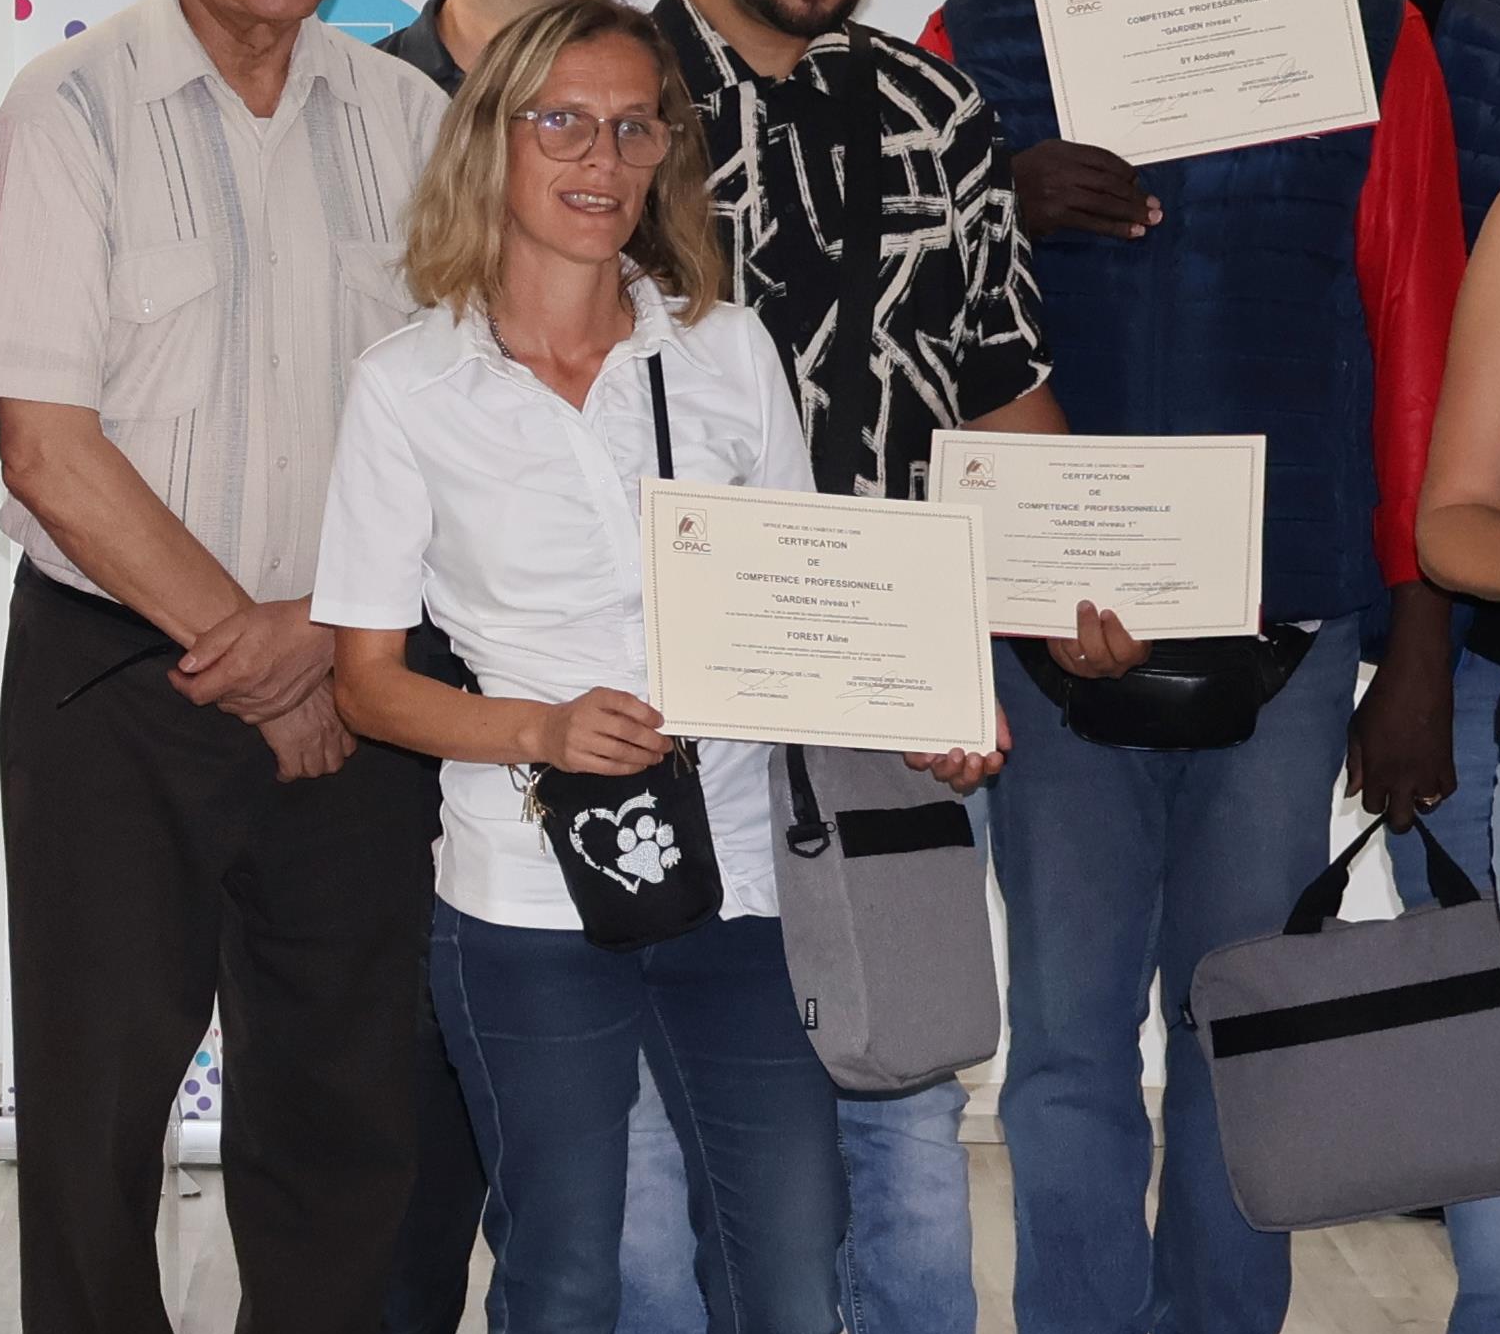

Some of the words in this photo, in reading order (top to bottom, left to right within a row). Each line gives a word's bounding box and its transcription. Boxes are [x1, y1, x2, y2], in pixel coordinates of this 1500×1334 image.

[1066, 0, 1102, 16] OPAC
[1127, 8, 1185, 26] COMPETENCE
[1205, 17, 1232, 28] niveau
[1062, 473, 1130, 481] CERTIFICATION
[959, 478, 997, 488] OPAC
[1088, 489, 1101, 497] DE
[1018, 502, 1079, 511] COMPETENCE
[1084, 504, 1171, 513] PROFESSIONNELLE
[672, 540, 711, 553] OPAC
[778, 536, 848, 549] CERTIFICATION
[807, 558, 820, 567] DE
[736, 571, 800, 585] COMPETENCE
[804, 577, 894, 591] PROFESSIONNELLE
[820, 599, 849, 607] niveau
[787, 631, 824, 642] FOREST
[826, 633, 849, 644] Aline
